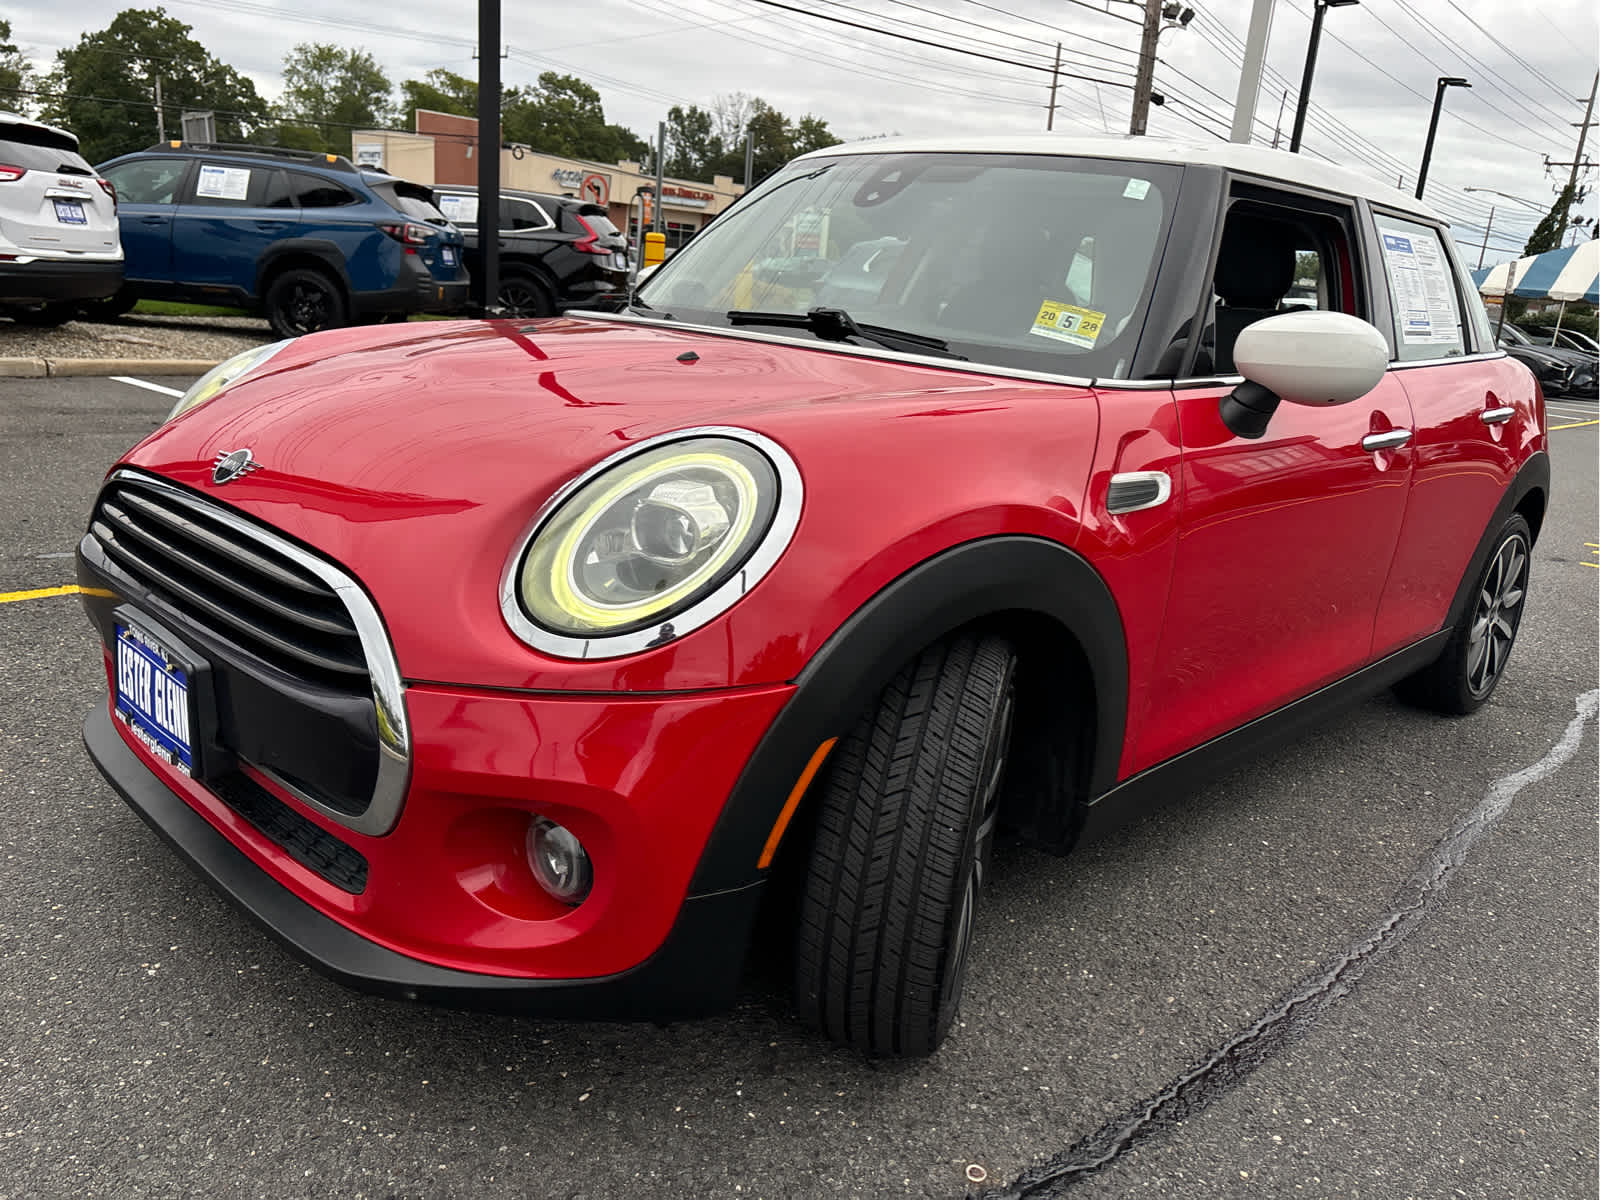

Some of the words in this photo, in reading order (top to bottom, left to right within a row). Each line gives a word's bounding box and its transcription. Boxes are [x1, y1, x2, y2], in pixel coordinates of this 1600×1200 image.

[1041, 311, 1056, 321] 20
[1063, 315, 1075, 329] 5
[1082, 321, 1098, 332] 28
[118, 639, 152, 717] LESTER
[155, 668, 191, 747] GLENN
